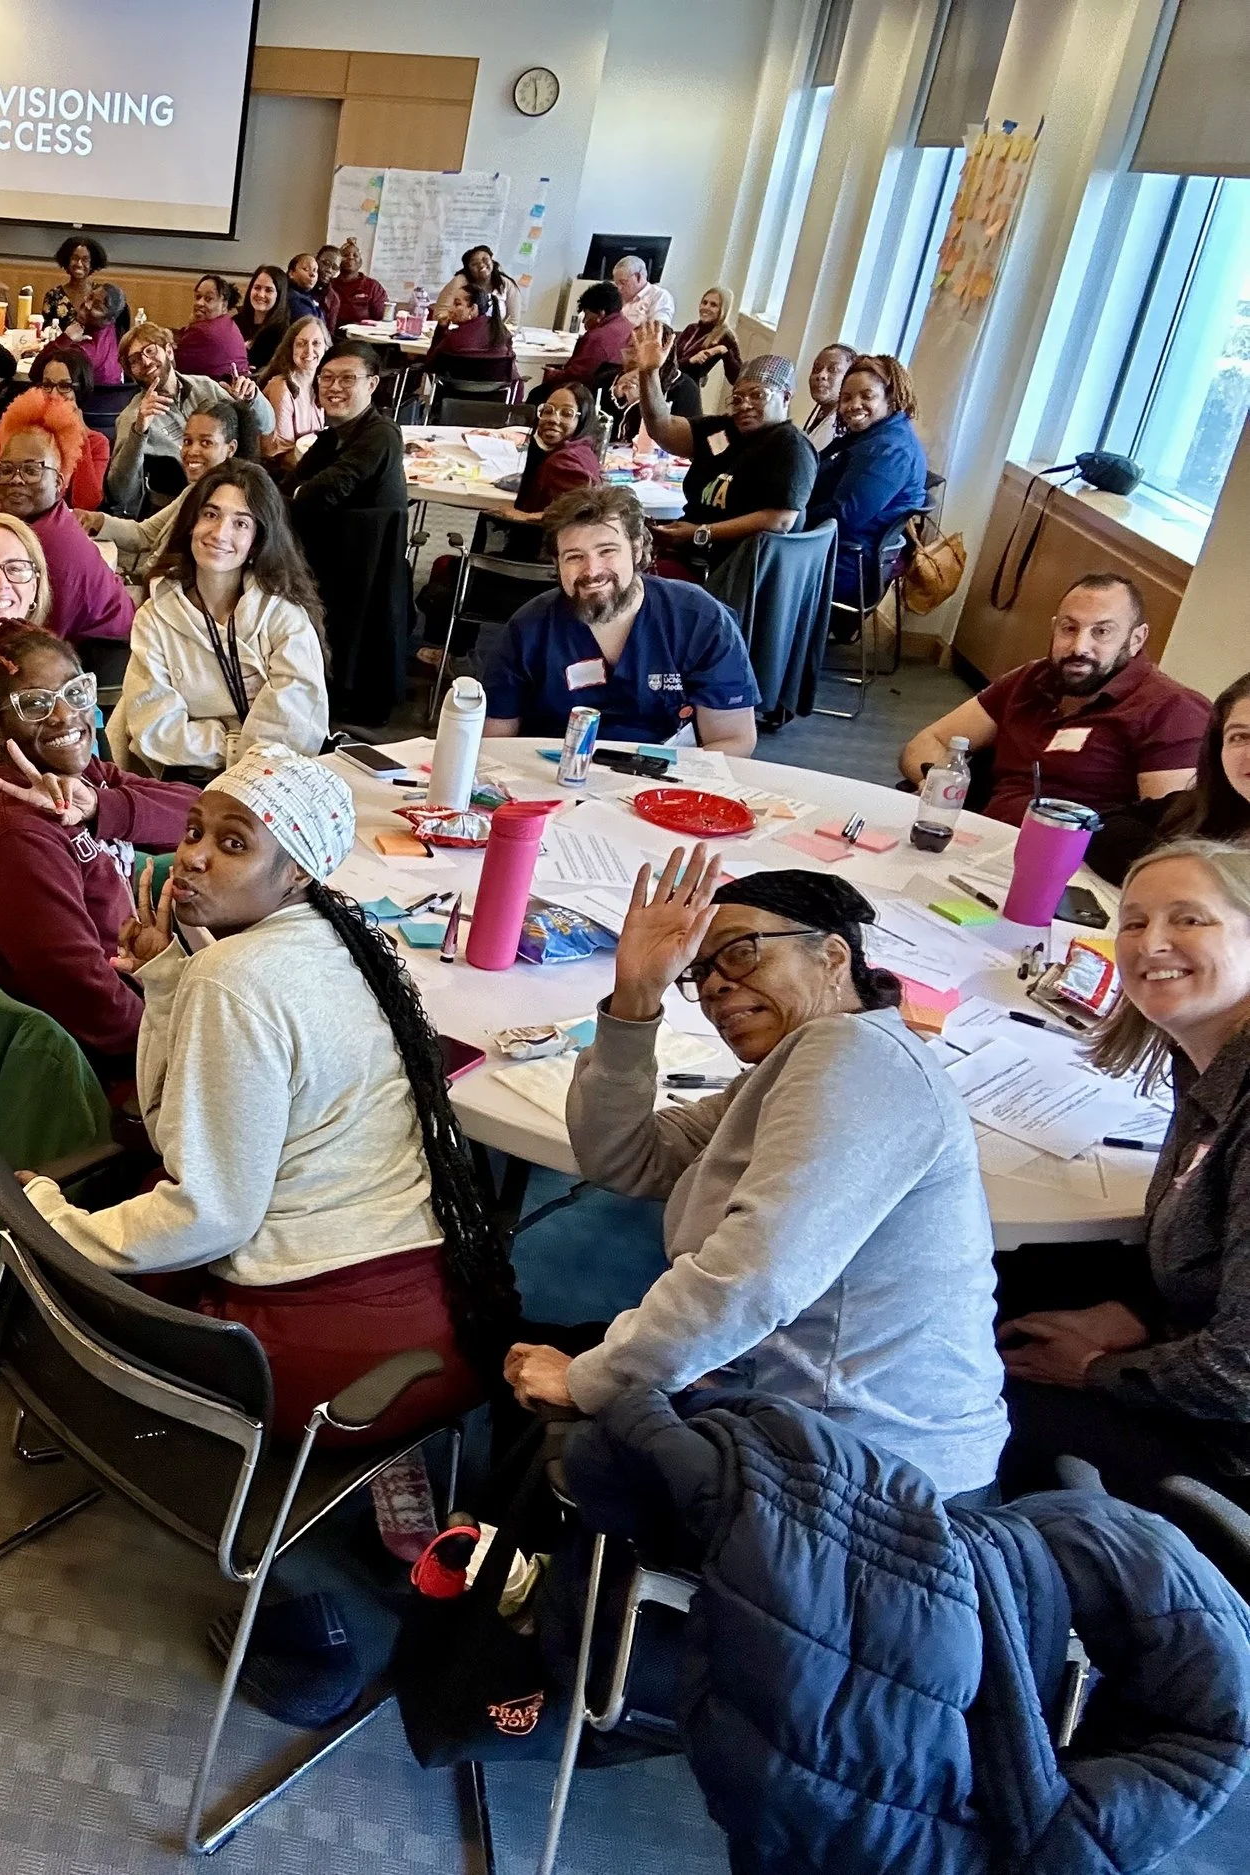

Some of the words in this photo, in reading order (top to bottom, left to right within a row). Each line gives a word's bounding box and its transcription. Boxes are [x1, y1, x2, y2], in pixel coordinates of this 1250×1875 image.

[942, 784, 967, 801] Co
[487, 1704, 539, 1721] TRAD
[494, 1717, 531, 1728] JOE
